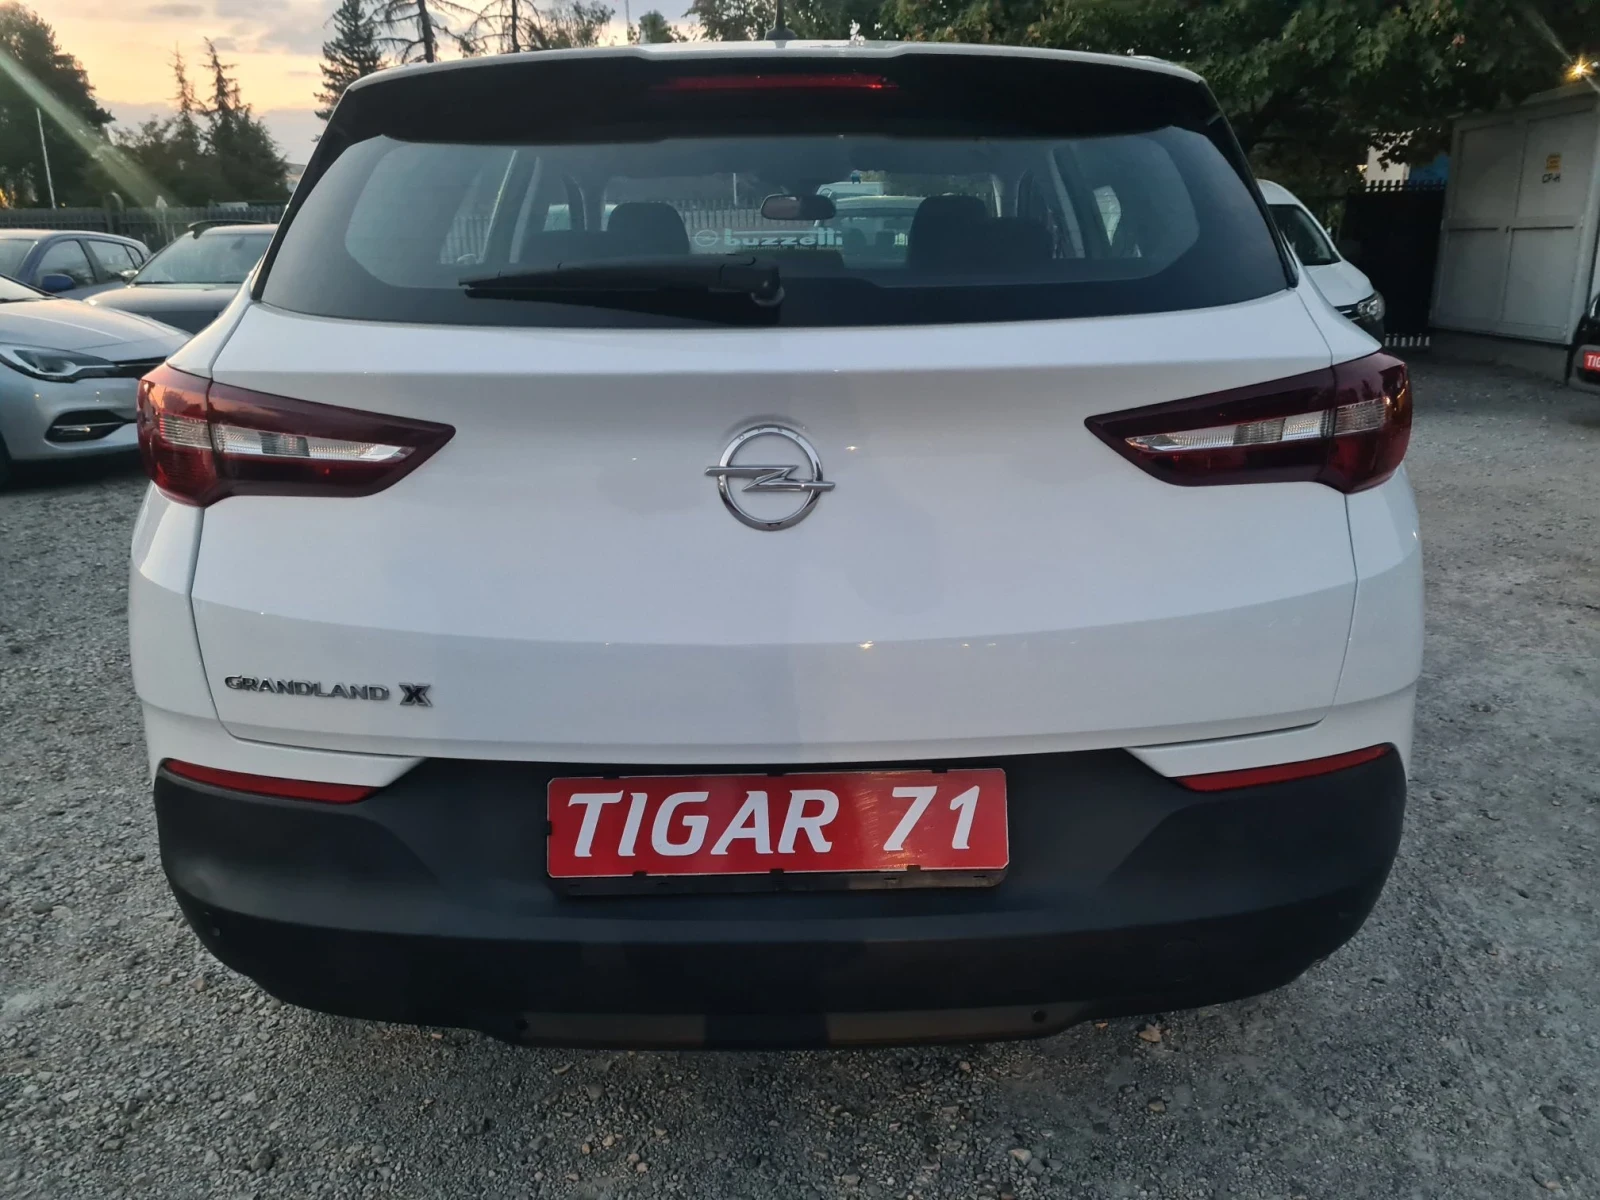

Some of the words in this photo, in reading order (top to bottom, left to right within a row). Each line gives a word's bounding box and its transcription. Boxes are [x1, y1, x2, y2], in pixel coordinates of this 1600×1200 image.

[724, 228, 843, 246] buzzelli
[225, 675, 390, 701] GRANDLAND
[399, 682, 433, 707] X
[568, 790, 840, 857] TIGAR
[883, 785, 981, 851] 71
